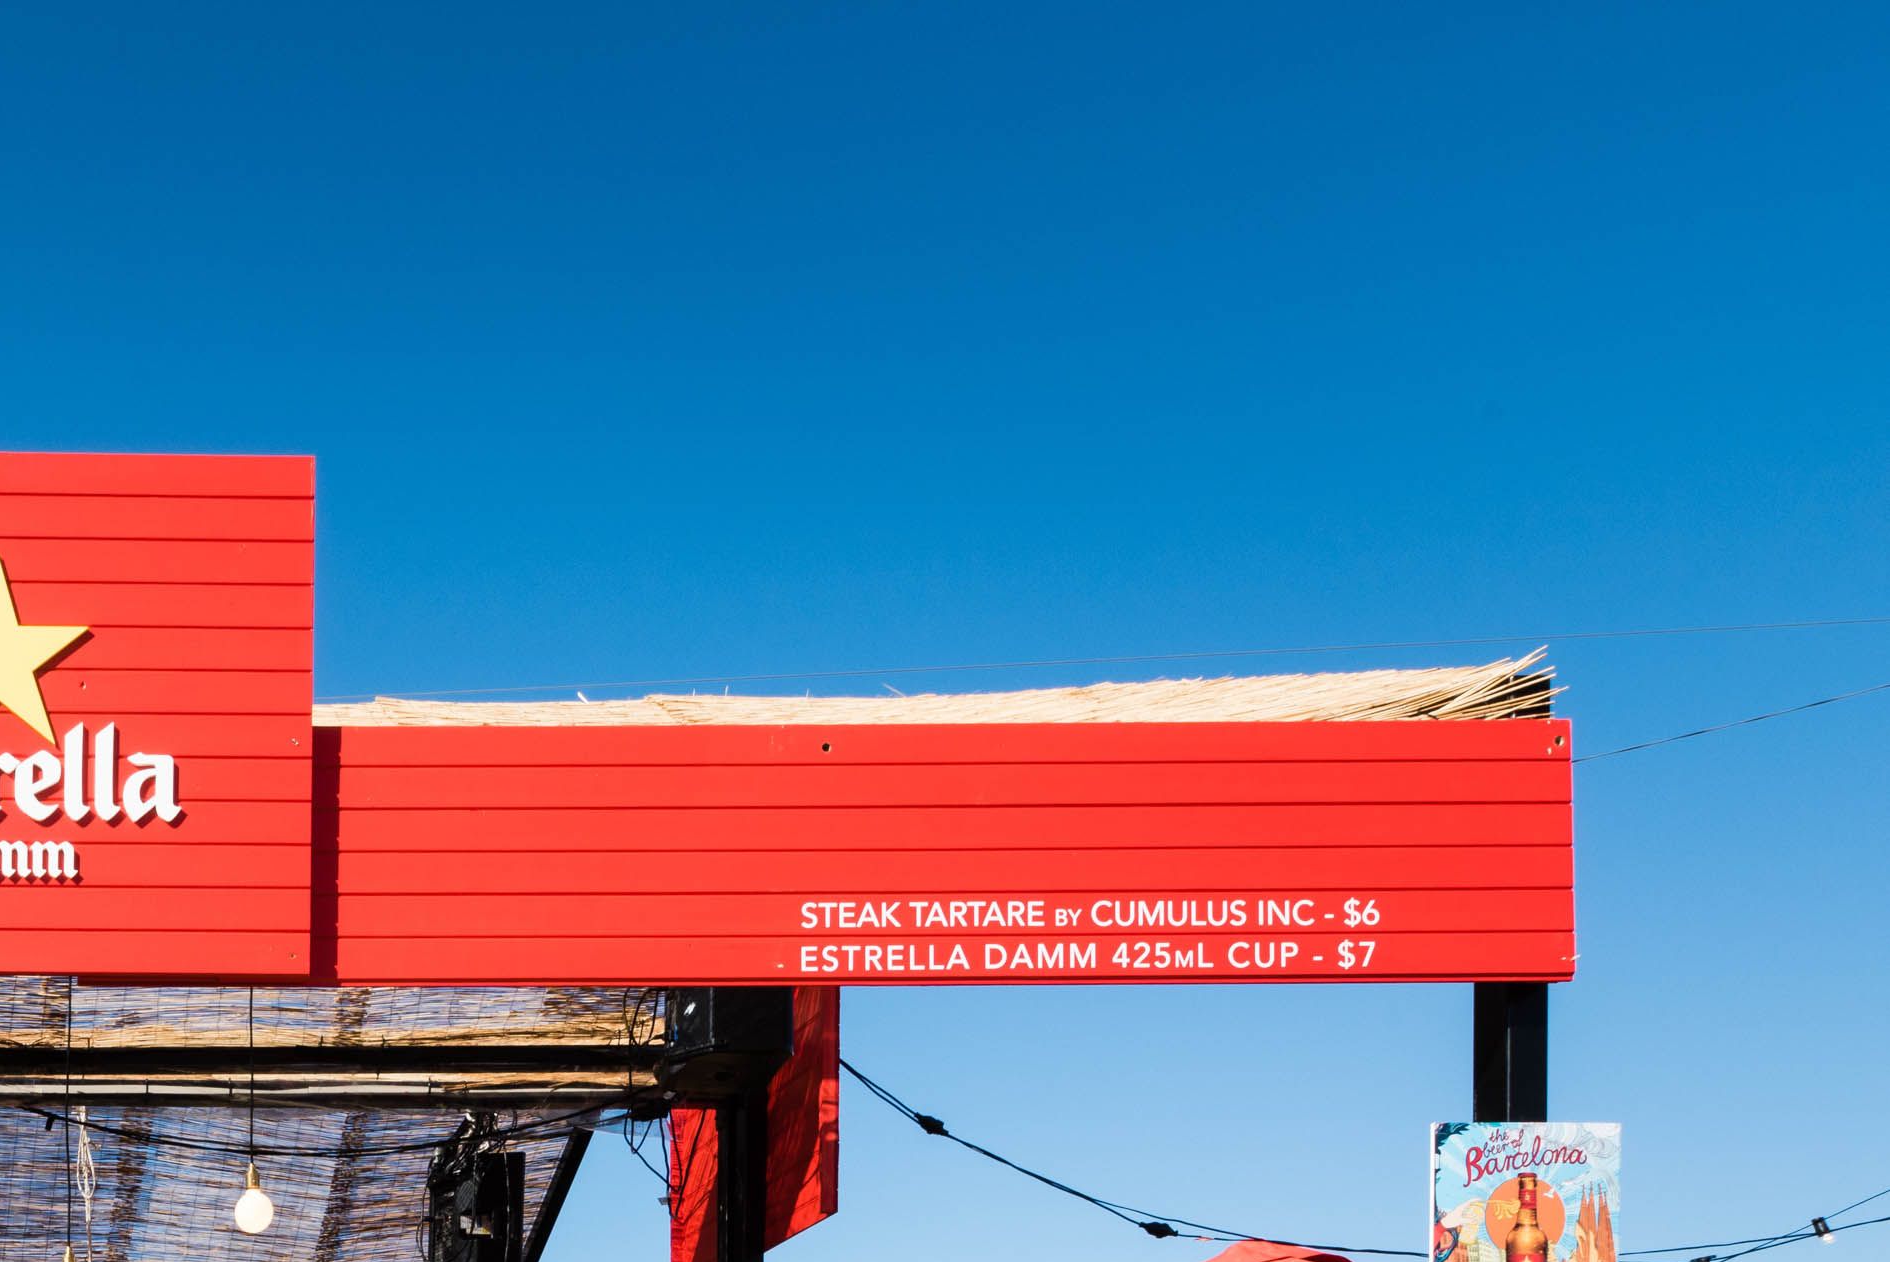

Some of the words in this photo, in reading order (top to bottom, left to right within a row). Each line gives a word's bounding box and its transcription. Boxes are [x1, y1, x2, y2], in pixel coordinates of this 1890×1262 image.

[801, 902, 902, 928] STEAK
[909, 901, 1044, 927] TARTARE
[1055, 910, 1081, 925] BY
[1092, 900, 1246, 926] CUMULUS
[1258, 900, 1314, 926] INC
[1343, 898, 1380, 928] $6
[801, 944, 970, 972] ESTRELLA
[985, 943, 1096, 970] DAMM
[1228, 942, 1298, 968] CUP
[1338, 940, 1376, 970] $7
[1482, 1142, 1510, 1158] beer
[1491, 1129, 1509, 1142] the
[1463, 1135, 1587, 1187] Barcelona
